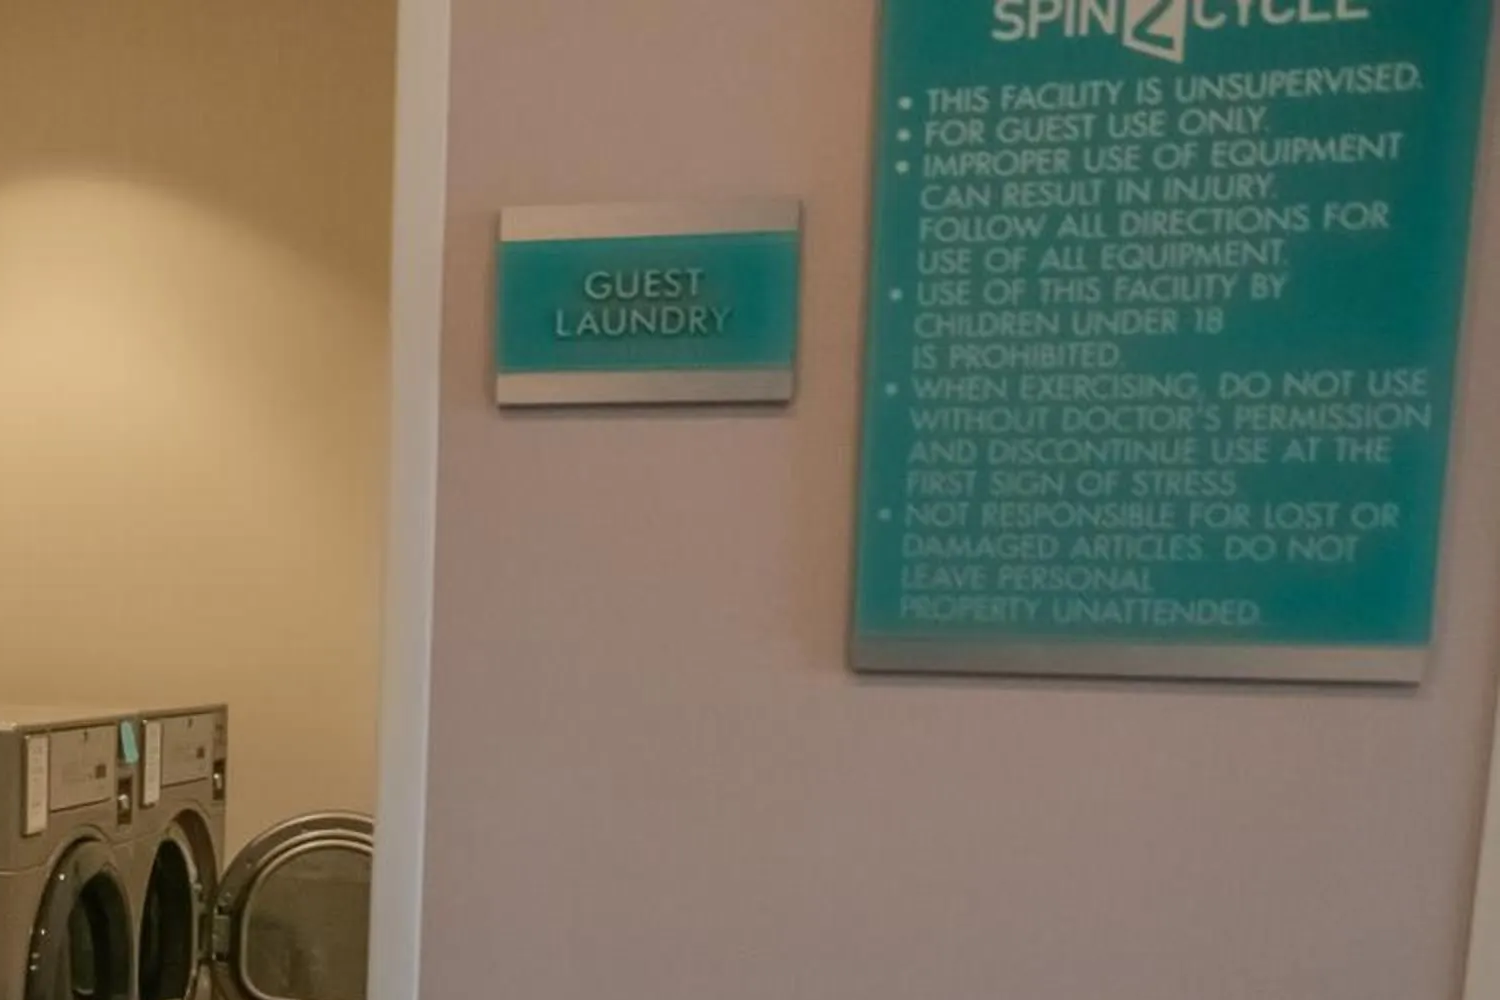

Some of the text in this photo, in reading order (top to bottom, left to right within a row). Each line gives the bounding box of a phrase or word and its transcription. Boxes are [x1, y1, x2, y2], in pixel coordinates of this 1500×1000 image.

[991, 0, 1116, 41] SPIN
[927, 86, 989, 113] THIS
[1001, 80, 1123, 111] FACILITY
[1135, 76, 1162, 104] IS
[925, 119, 985, 147] FOR
[996, 113, 1096, 143] GUEST
[1108, 109, 1165, 138] USE
[924, 131, 1403, 177] IMPROPER USE OF EQUIPMENT
[921, 184, 990, 211] CAN
[1003, 178, 1103, 209] RESULT
[1116, 177, 1150, 205] IN
[919, 200, 1390, 243] FOLLOW ALL DIRECTIONS FOR
[918, 249, 971, 275] USE
[984, 247, 1027, 273] OF
[1039, 245, 1088, 272] ALL
[585, 268, 702, 299] GUEST
[918, 271, 1287, 306] USE OF THIS FACILITY BY
[555, 305, 731, 336] LAUNDRY
[913, 306, 1224, 338] CHILDREN UNDER 18
[912, 344, 937, 370] IS
[912, 376, 1008, 400] WHEN
[1219, 370, 1272, 399] DO
[1283, 369, 1354, 398] NOT
[1368, 366, 1428, 396] USE
[910, 406, 1049, 433] WITHOUT
[1234, 402, 1432, 430] PERMISSION
[907, 435, 1392, 465] AND DISCONTINUE USE AT THE
[906, 469, 977, 496] FIRST
[989, 469, 1066, 497] SIGN
[1076, 469, 1121, 497] OF
[905, 500, 1400, 530] NOT RESPONSIBLE FOR LOST OR
[902, 533, 1060, 560] DAMAGED
[1225, 534, 1277, 561] DO
[1289, 534, 1360, 562] NOT
